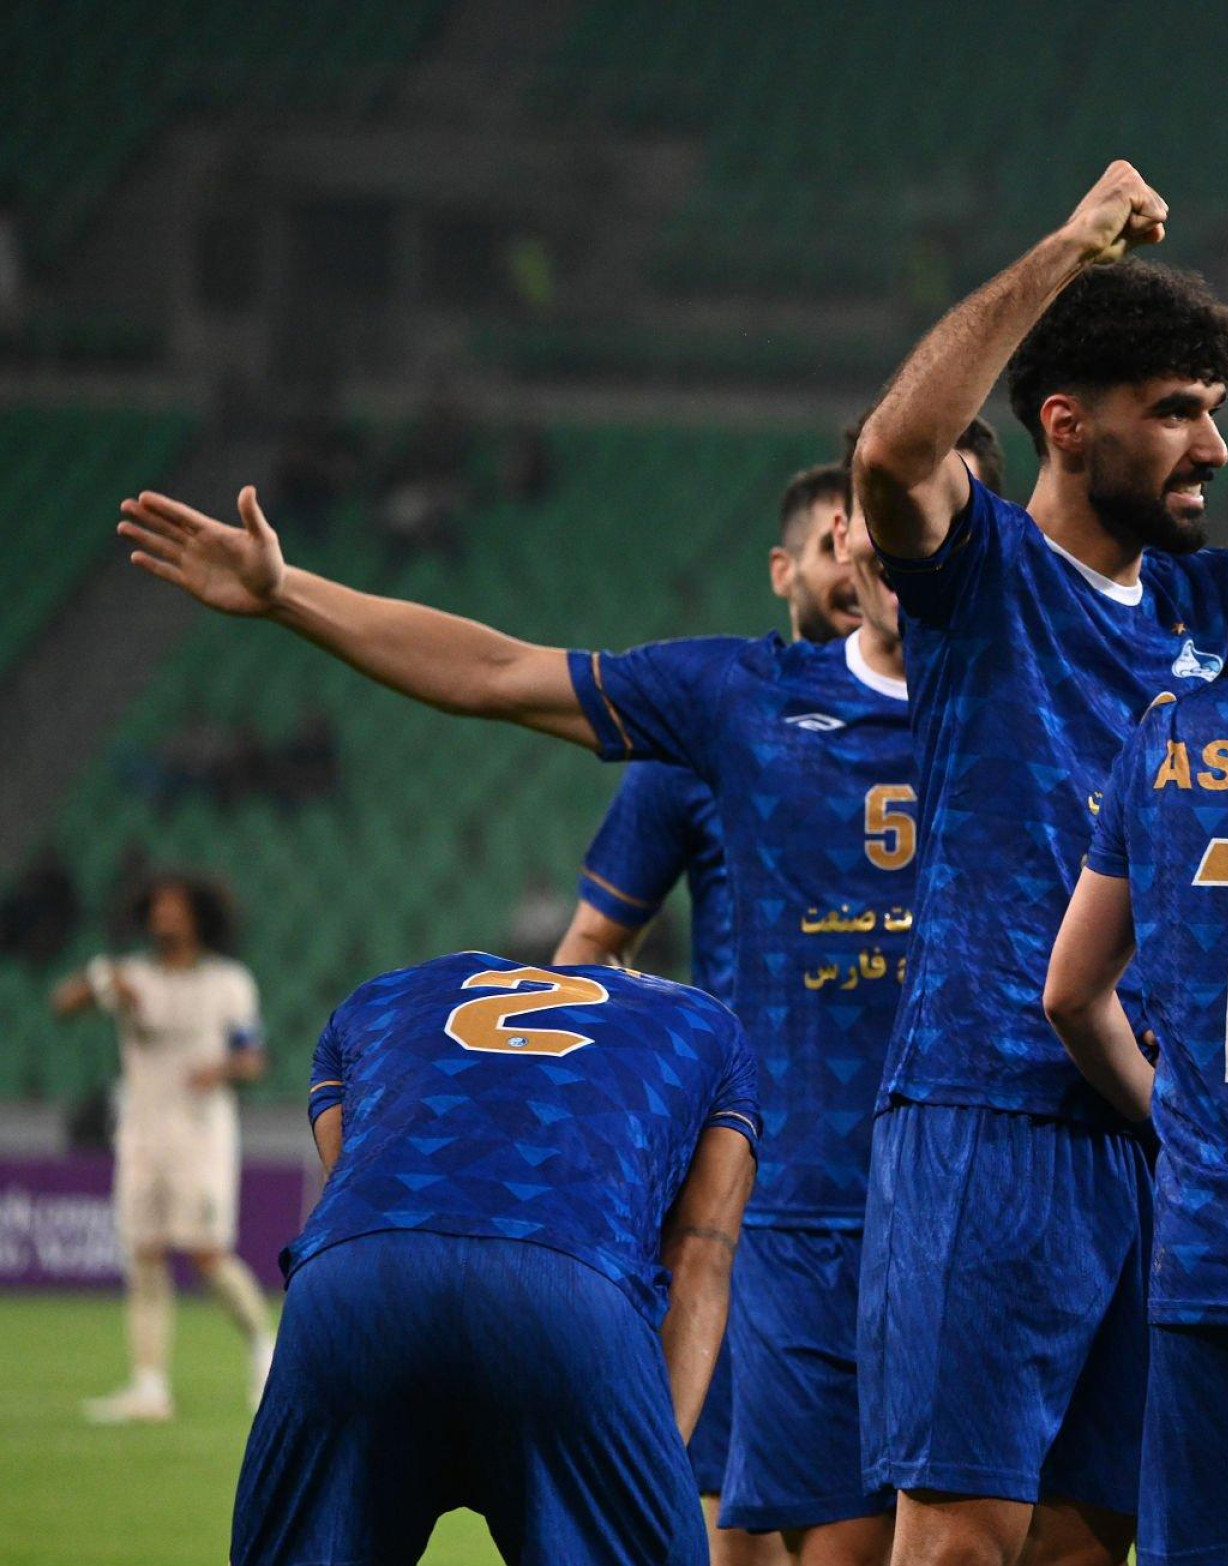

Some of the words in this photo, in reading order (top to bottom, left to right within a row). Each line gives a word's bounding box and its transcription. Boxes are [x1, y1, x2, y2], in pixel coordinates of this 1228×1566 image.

[864, 783, 918, 871] 5
[801, 903, 878, 934] صنعت
[804, 947, 888, 991] فارس
[444, 966, 610, 1058] 2
